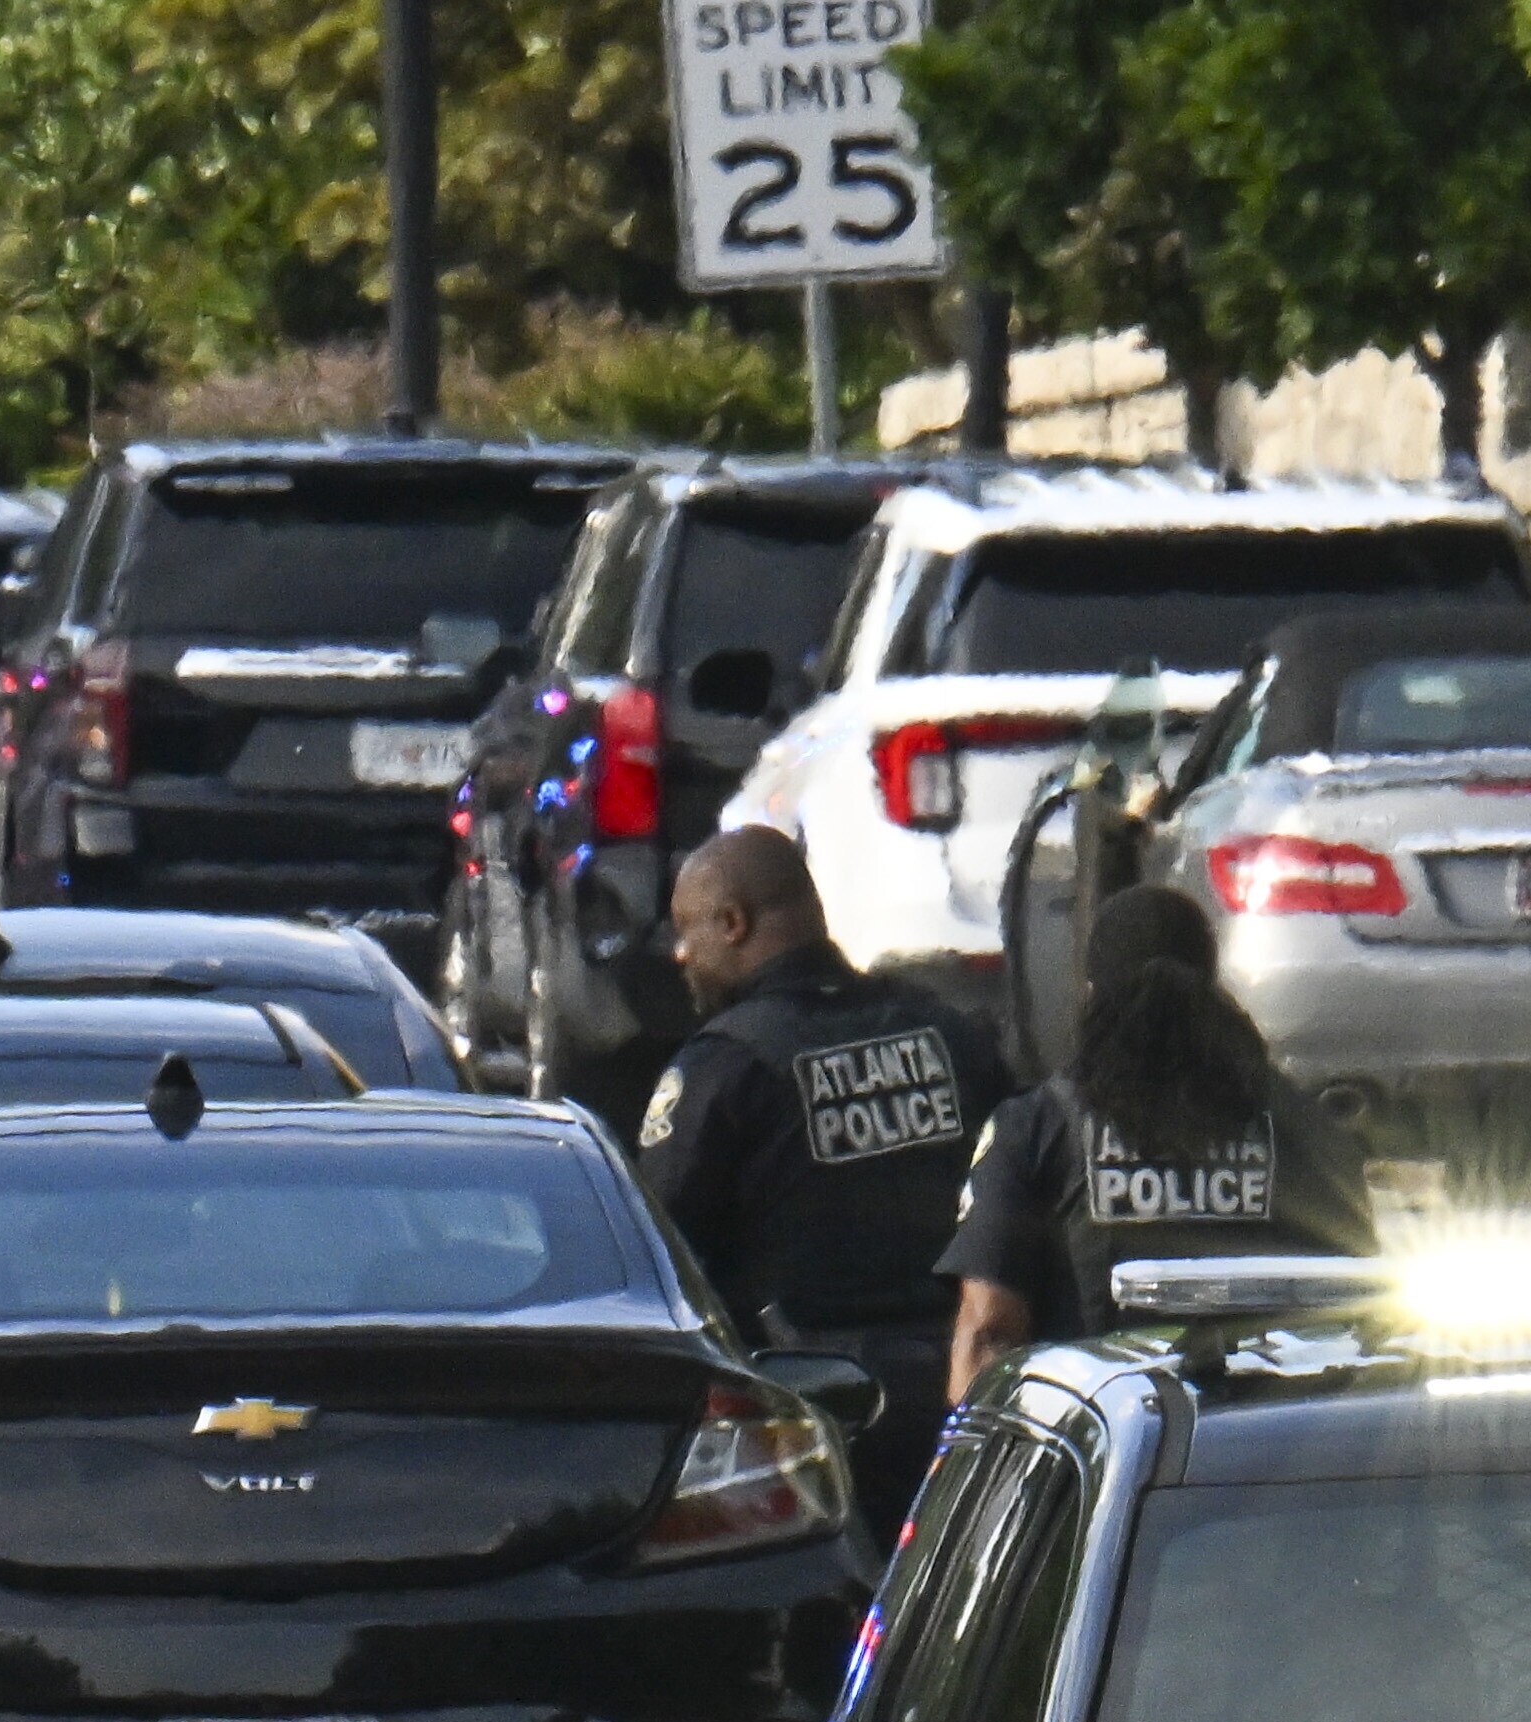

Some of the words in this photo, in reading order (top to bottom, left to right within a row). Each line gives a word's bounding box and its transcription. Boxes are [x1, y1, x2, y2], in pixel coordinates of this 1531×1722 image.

[695, 0, 906, 53] SPEED
[719, 61, 884, 117] LIMIT
[711, 132, 917, 253] 25
[810, 1036, 947, 1104] ATLANTA
[814, 1087, 958, 1157] POLICE
[1097, 1167, 1268, 1218] POLICE
[198, 1470, 317, 1492] VOLT
